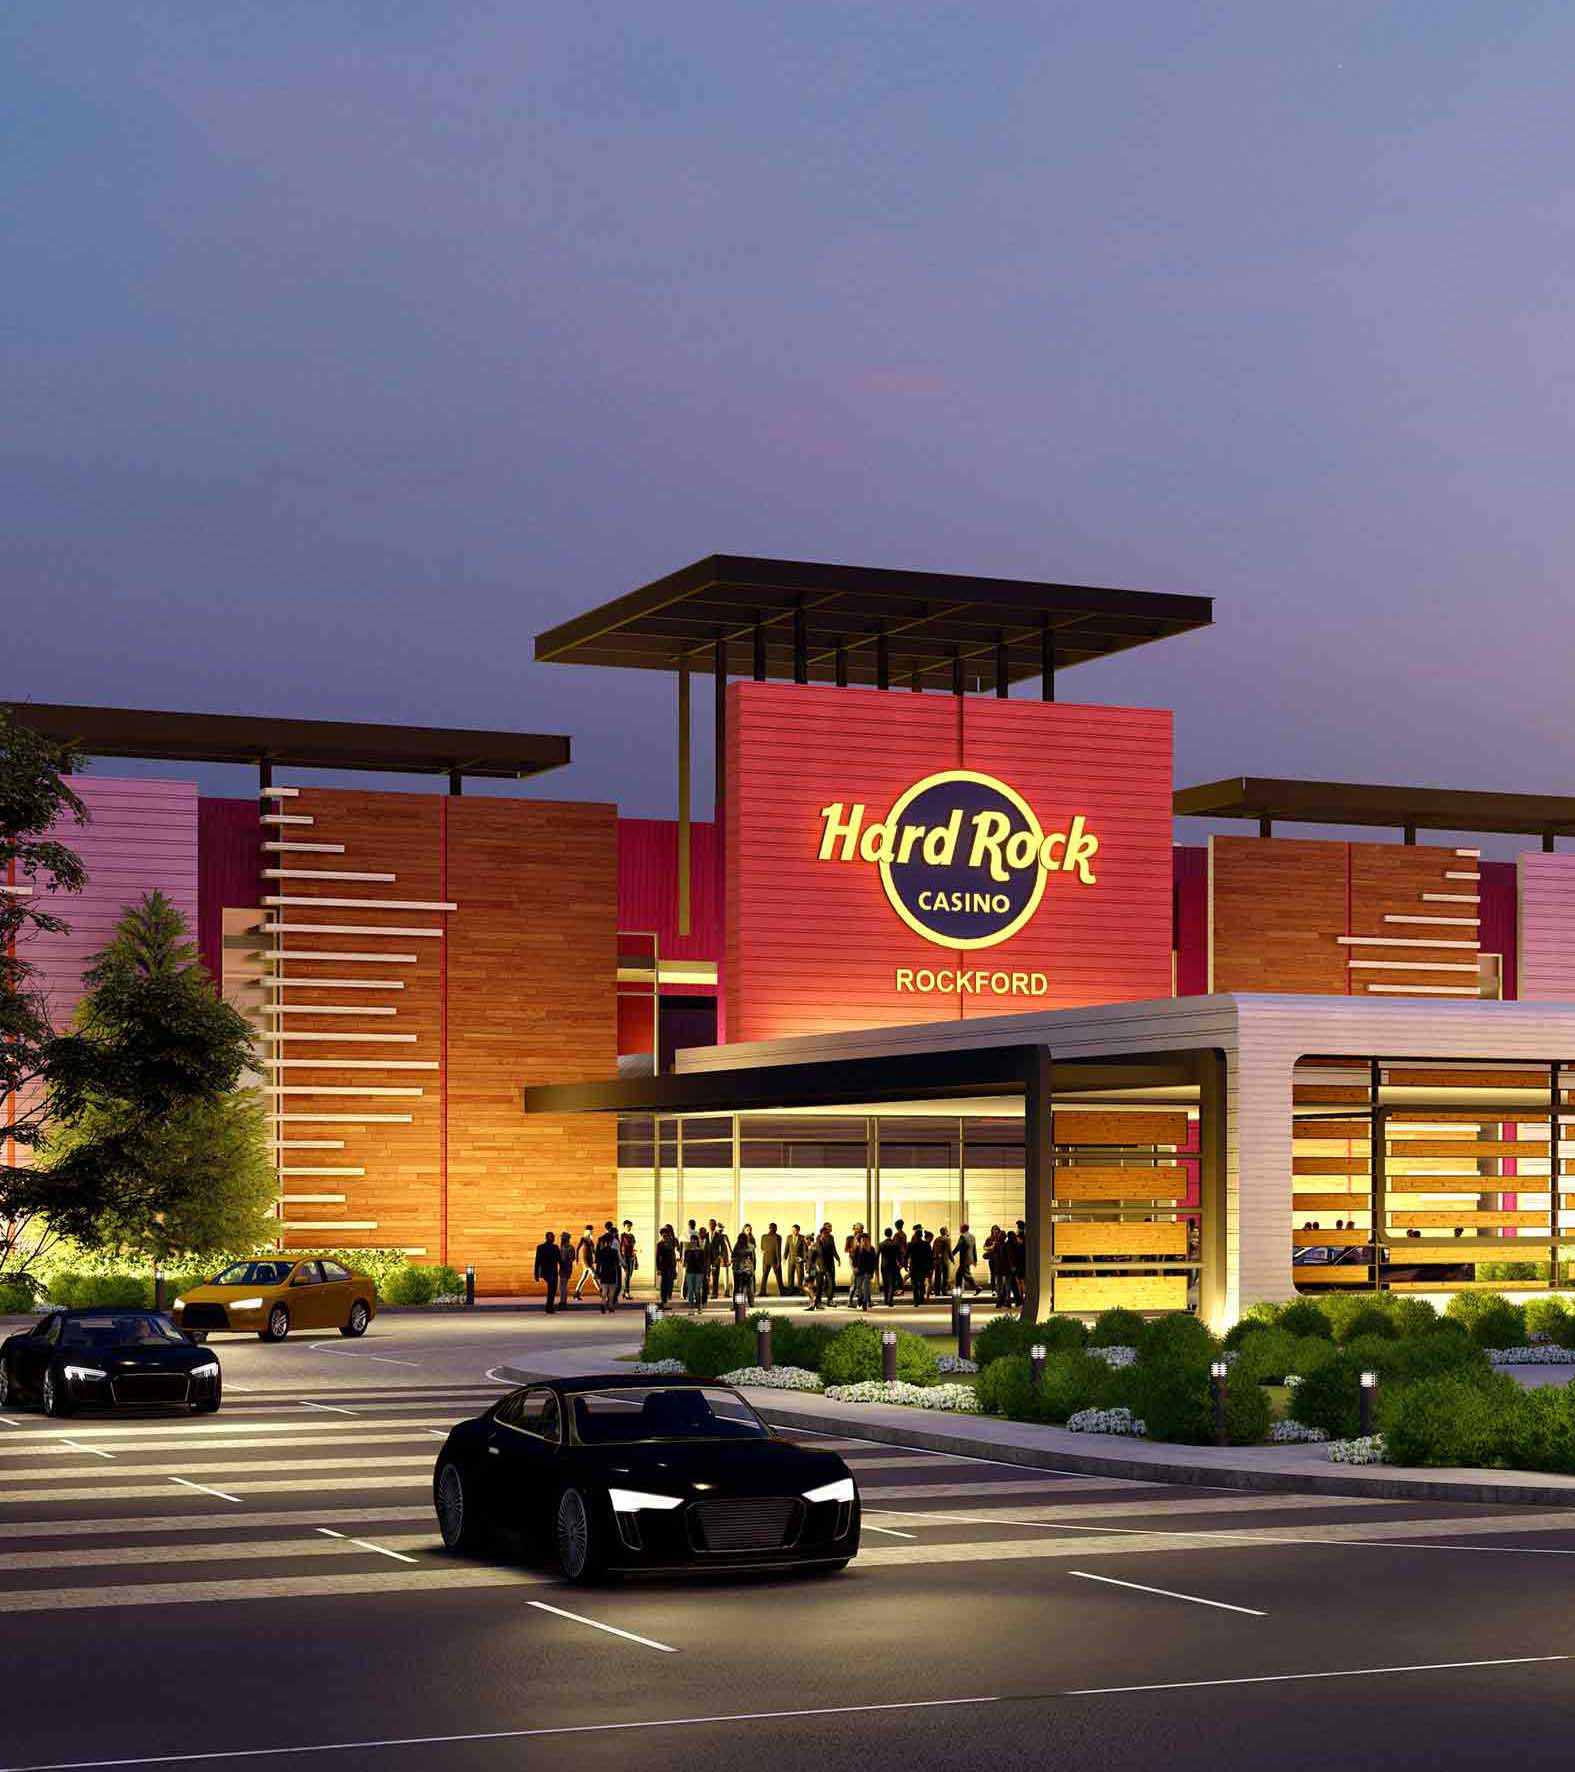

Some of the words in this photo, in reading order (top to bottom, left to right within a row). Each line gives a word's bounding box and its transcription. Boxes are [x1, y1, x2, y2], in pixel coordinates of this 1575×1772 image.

[818, 802, 964, 866] Hard
[968, 811, 1099, 885] Rock
[918, 891, 1011, 914] CASINO
[895, 968, 1049, 996] ROCKFORD
